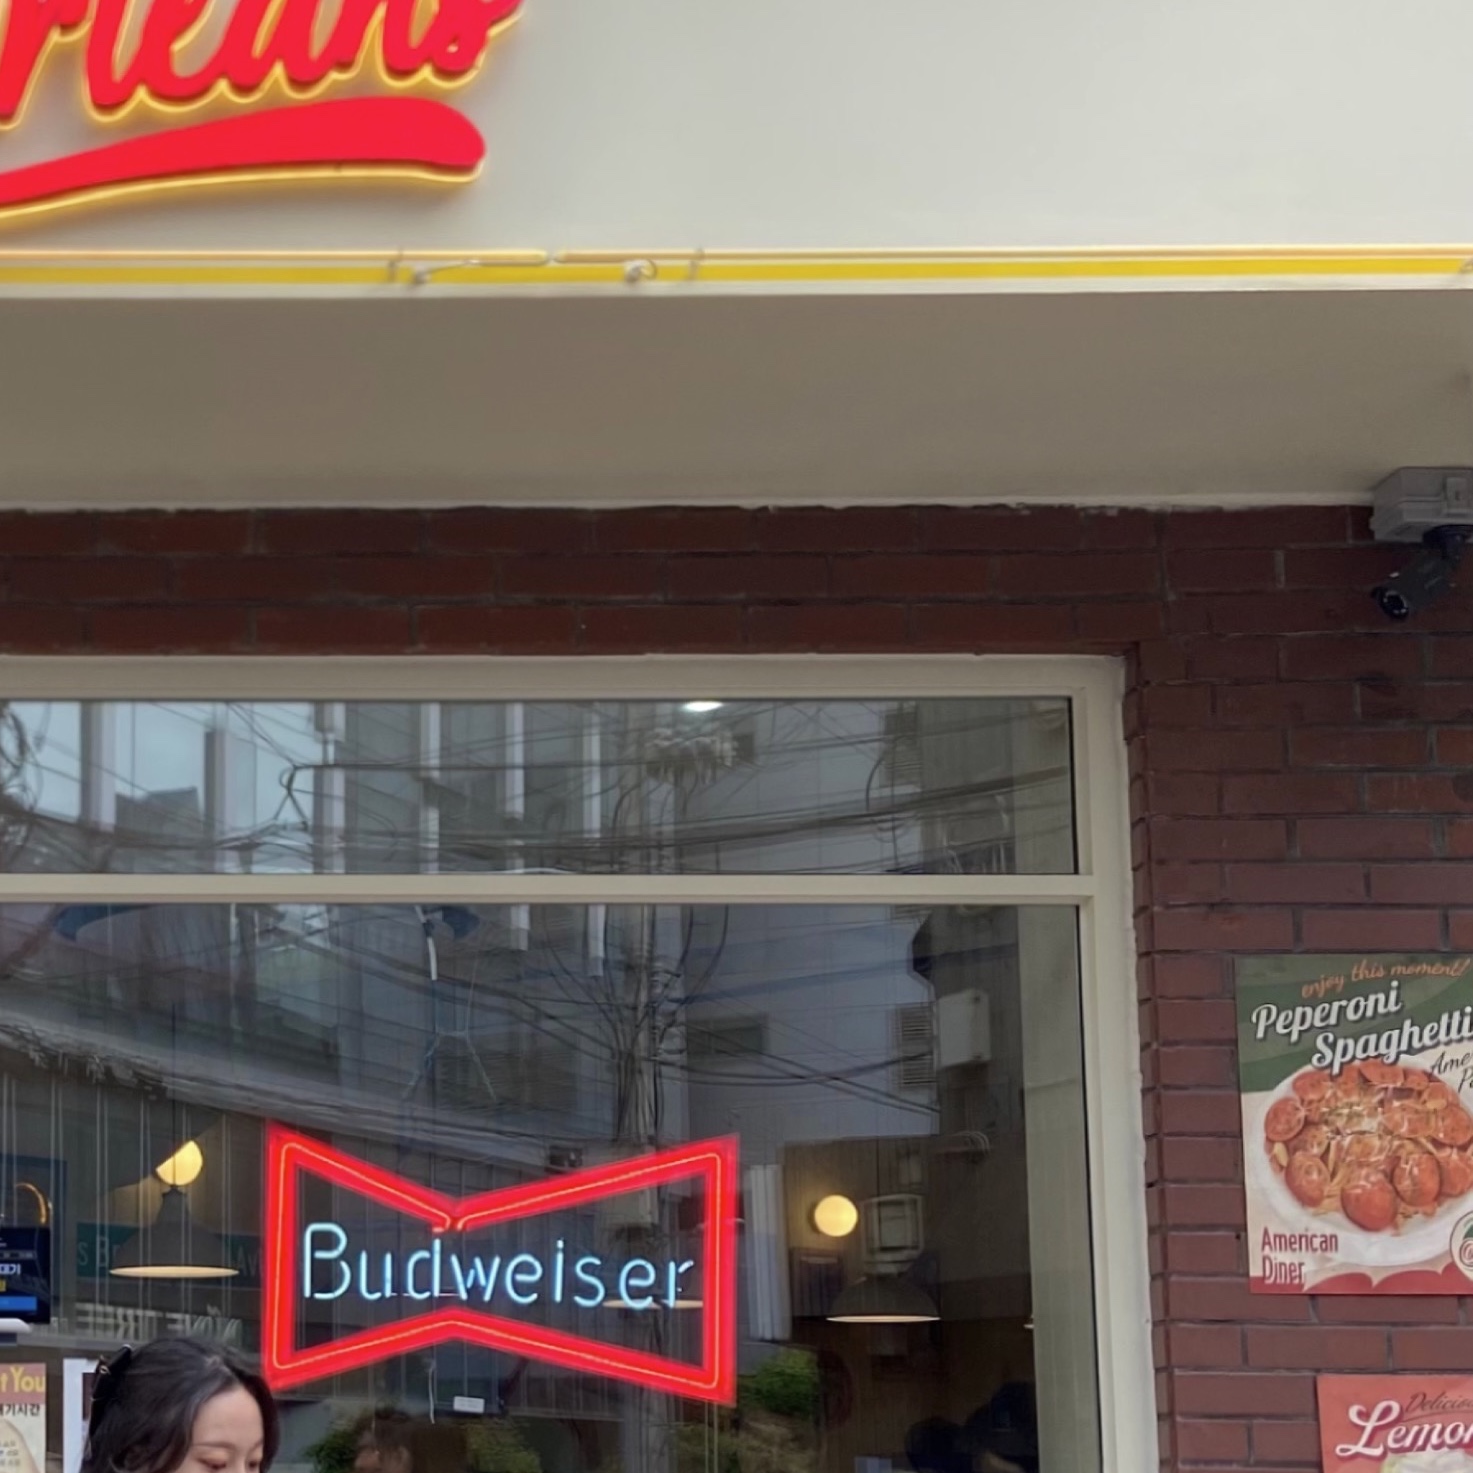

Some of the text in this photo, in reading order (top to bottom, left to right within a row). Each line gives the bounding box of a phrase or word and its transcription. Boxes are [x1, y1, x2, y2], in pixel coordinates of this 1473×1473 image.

[1301, 973, 1345, 999] enjoy
[1351, 958, 1385, 982] this
[1251, 980, 1404, 1042] Peperoni
[1311, 1006, 1473, 1076] Spaghetti
[1261, 1228, 1338, 1254] American
[303, 1222, 694, 1310] Budweiser
[1262, 1254, 1305, 1285] Diner
[10, 1366, 45, 1393] You
